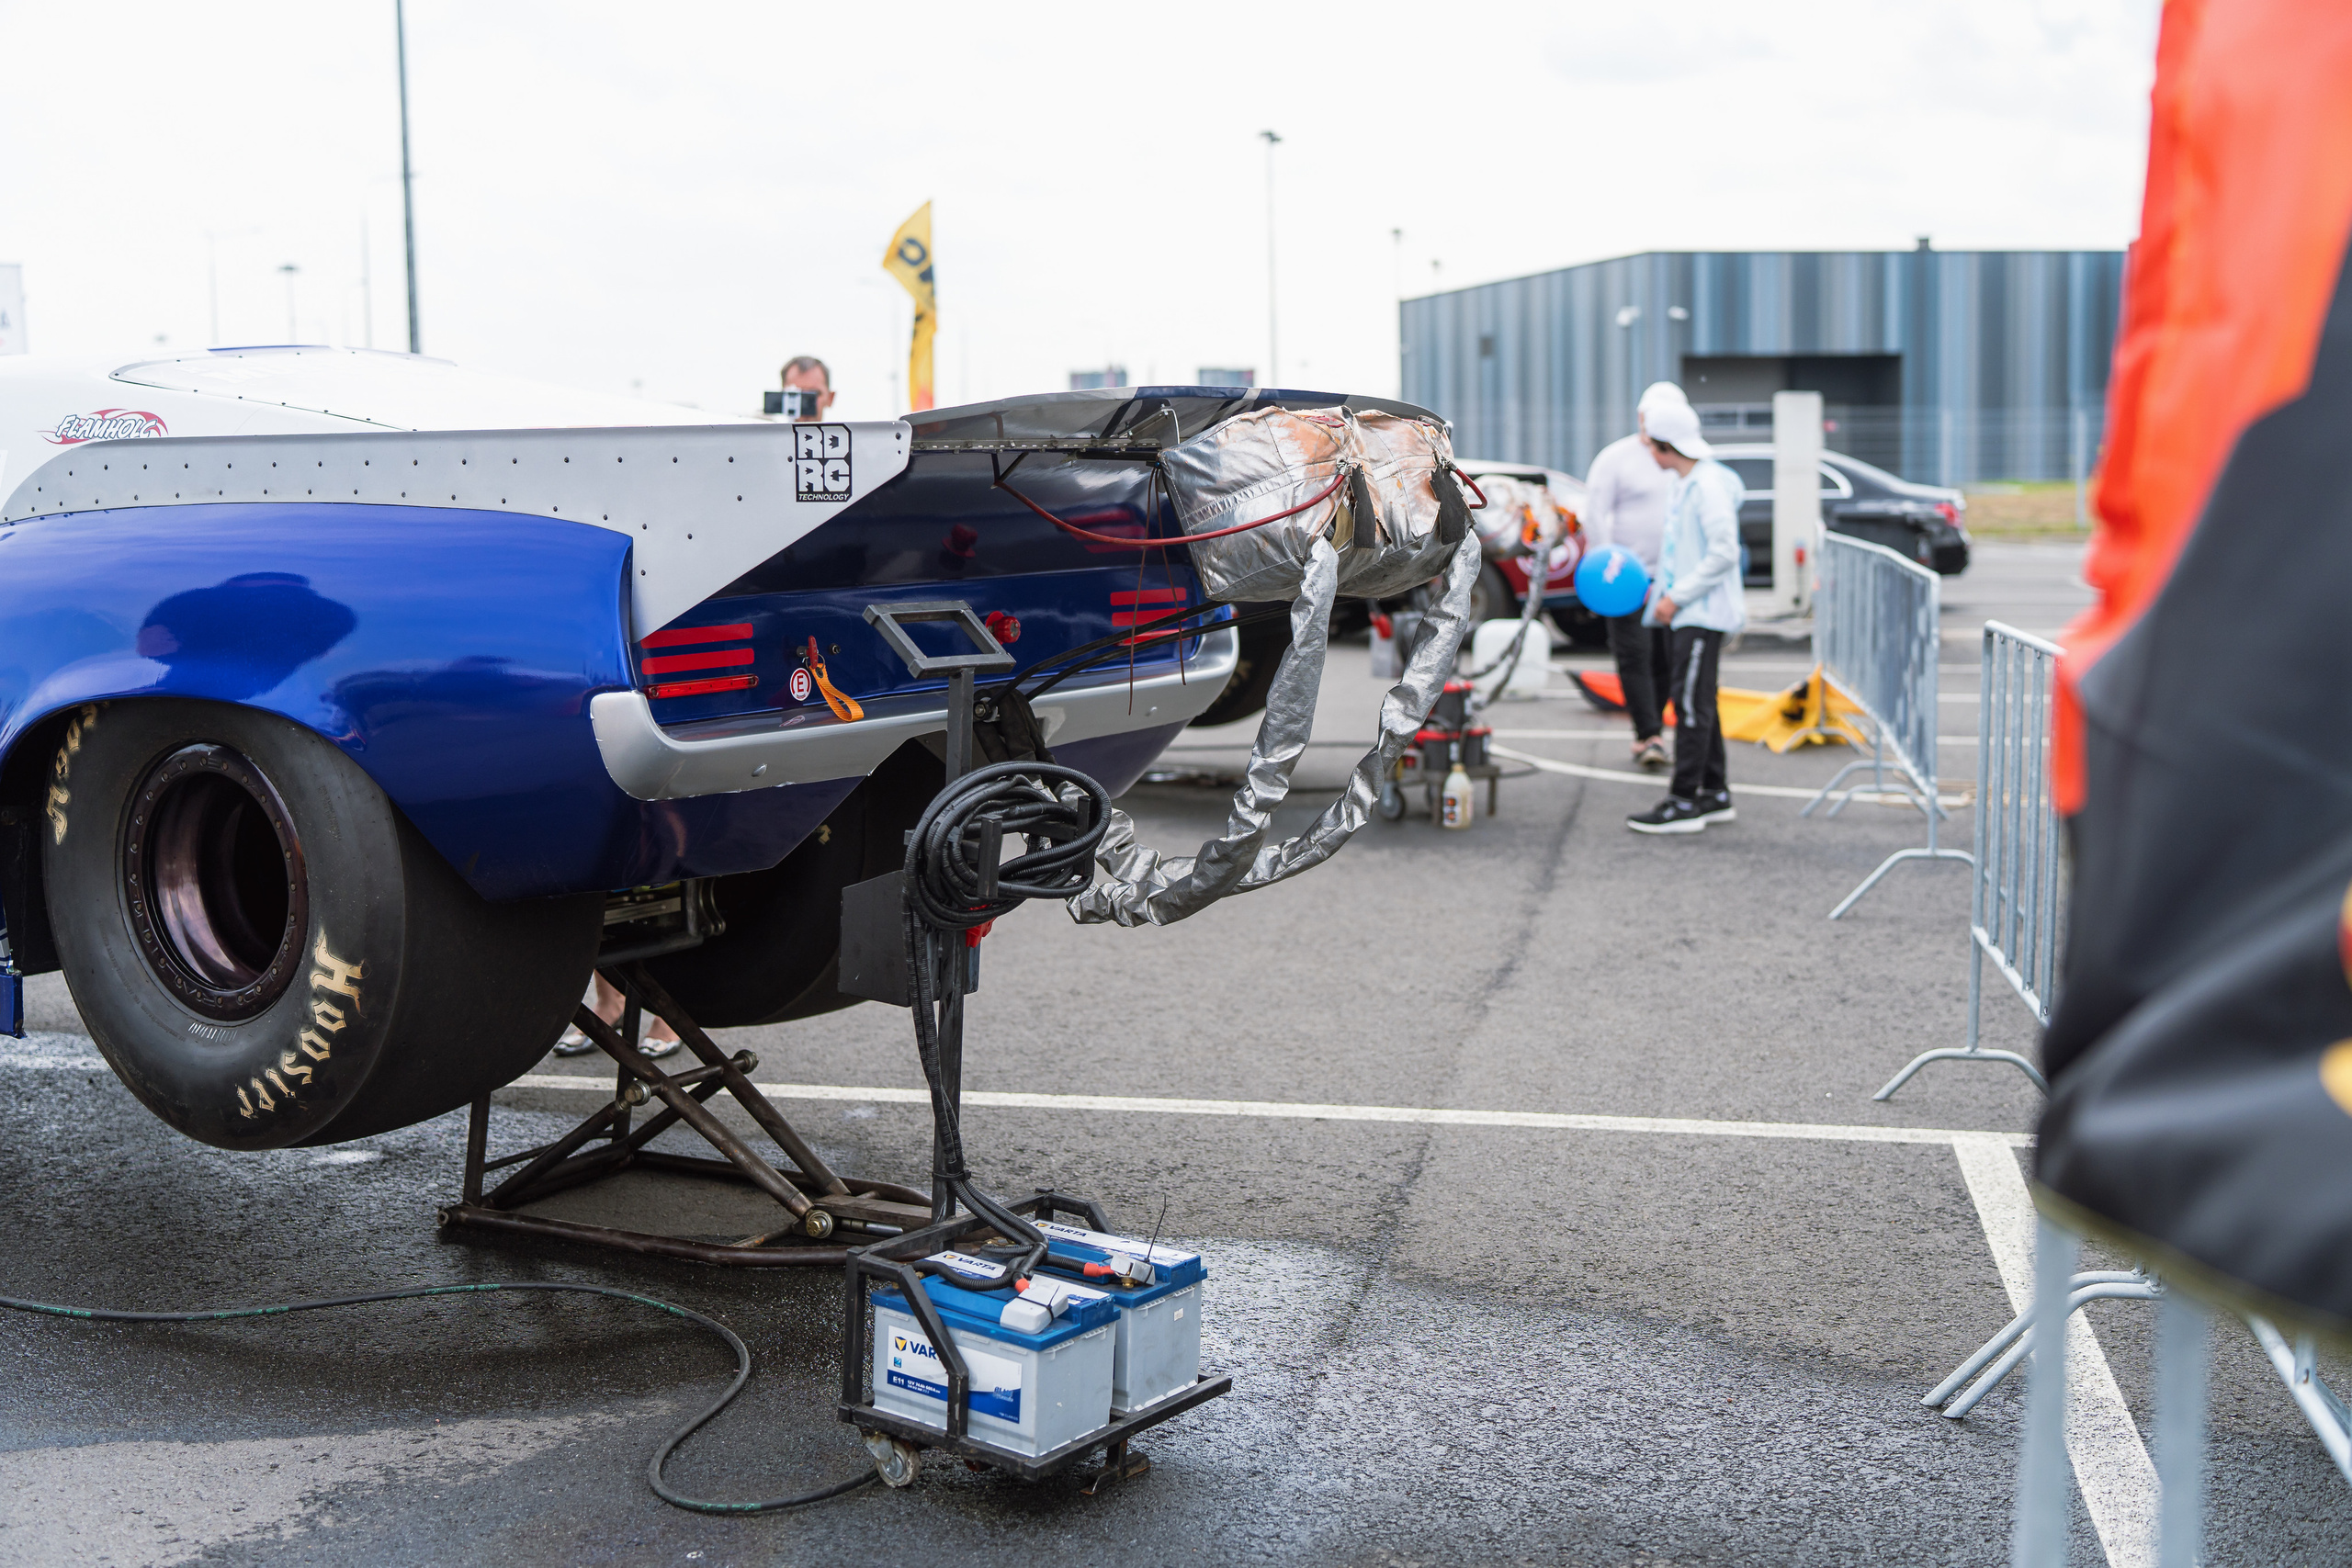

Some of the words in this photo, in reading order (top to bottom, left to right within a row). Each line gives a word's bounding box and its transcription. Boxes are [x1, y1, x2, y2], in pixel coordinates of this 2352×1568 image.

[797, 674, 805, 694] E
[1049, 1225, 1087, 1237] VARTA
[957, 1257, 996, 1271] VARTA
[910, 1340, 938, 1360] VAR
[892, 1375, 905, 1386] E11
